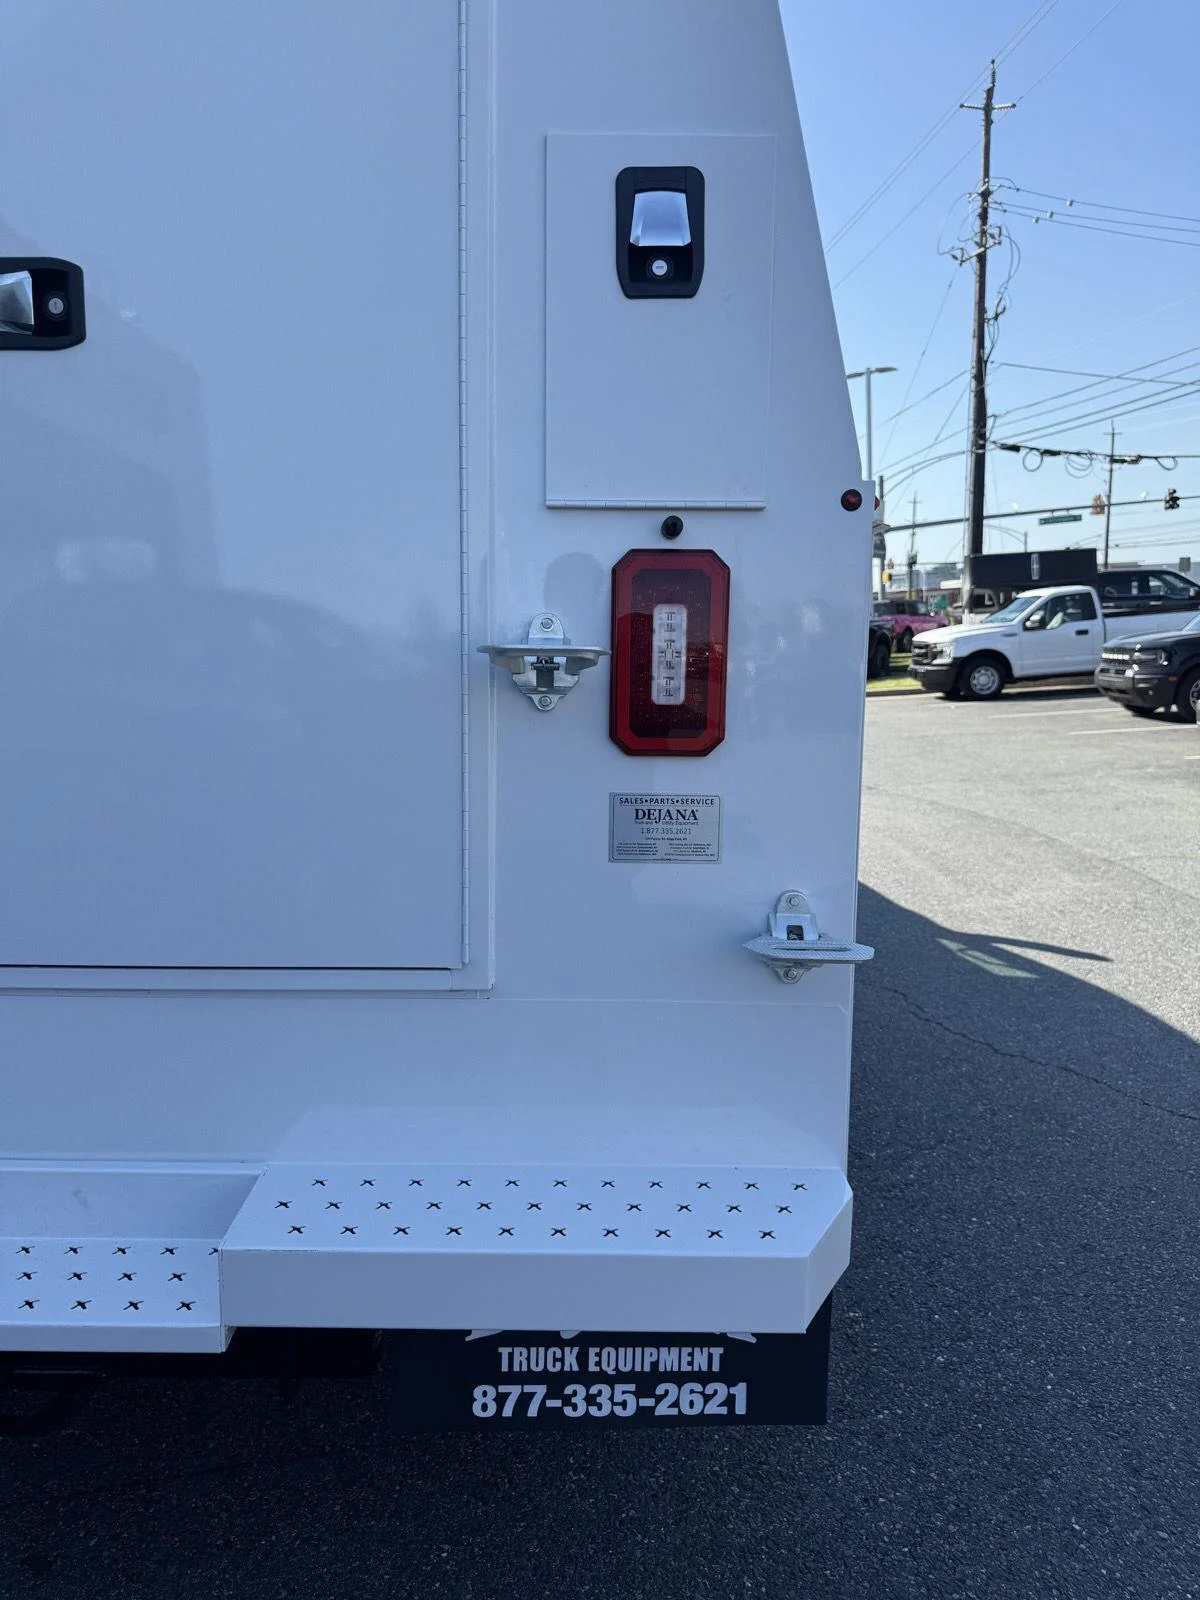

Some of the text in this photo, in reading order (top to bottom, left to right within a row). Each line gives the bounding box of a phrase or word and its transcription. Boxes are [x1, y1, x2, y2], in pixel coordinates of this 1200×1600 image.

[498, 1346, 724, 1375] TRUCK EQUIPMENT
[472, 1382, 748, 1418] 877-335-2621
